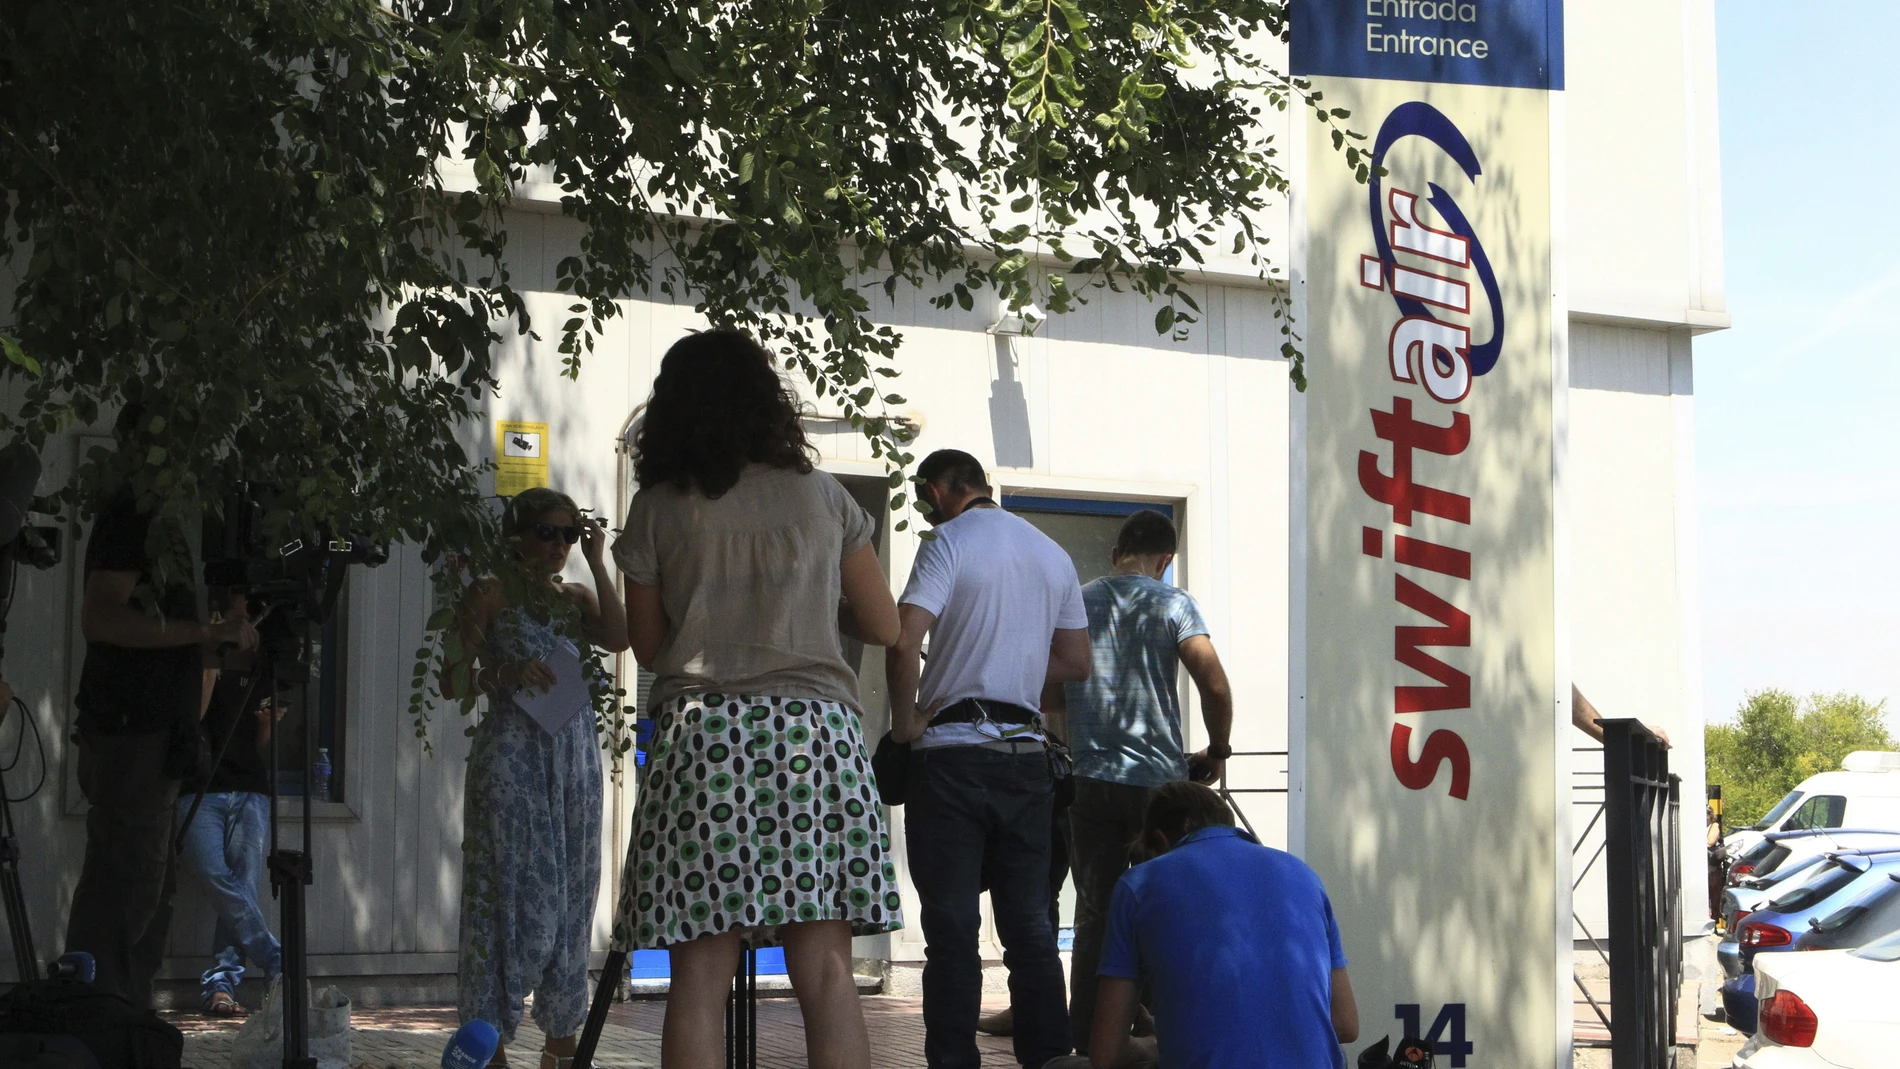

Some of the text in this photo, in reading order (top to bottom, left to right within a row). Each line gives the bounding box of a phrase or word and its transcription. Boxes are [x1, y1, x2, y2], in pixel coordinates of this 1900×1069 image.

[1367, 0, 1476, 22] Entrada
[1367, 22, 1489, 59] Entrance
[1357, 187, 1472, 801] swiftair
[1395, 1003, 1473, 1068] 14
[453, 1045, 477, 1064] FRANCE
